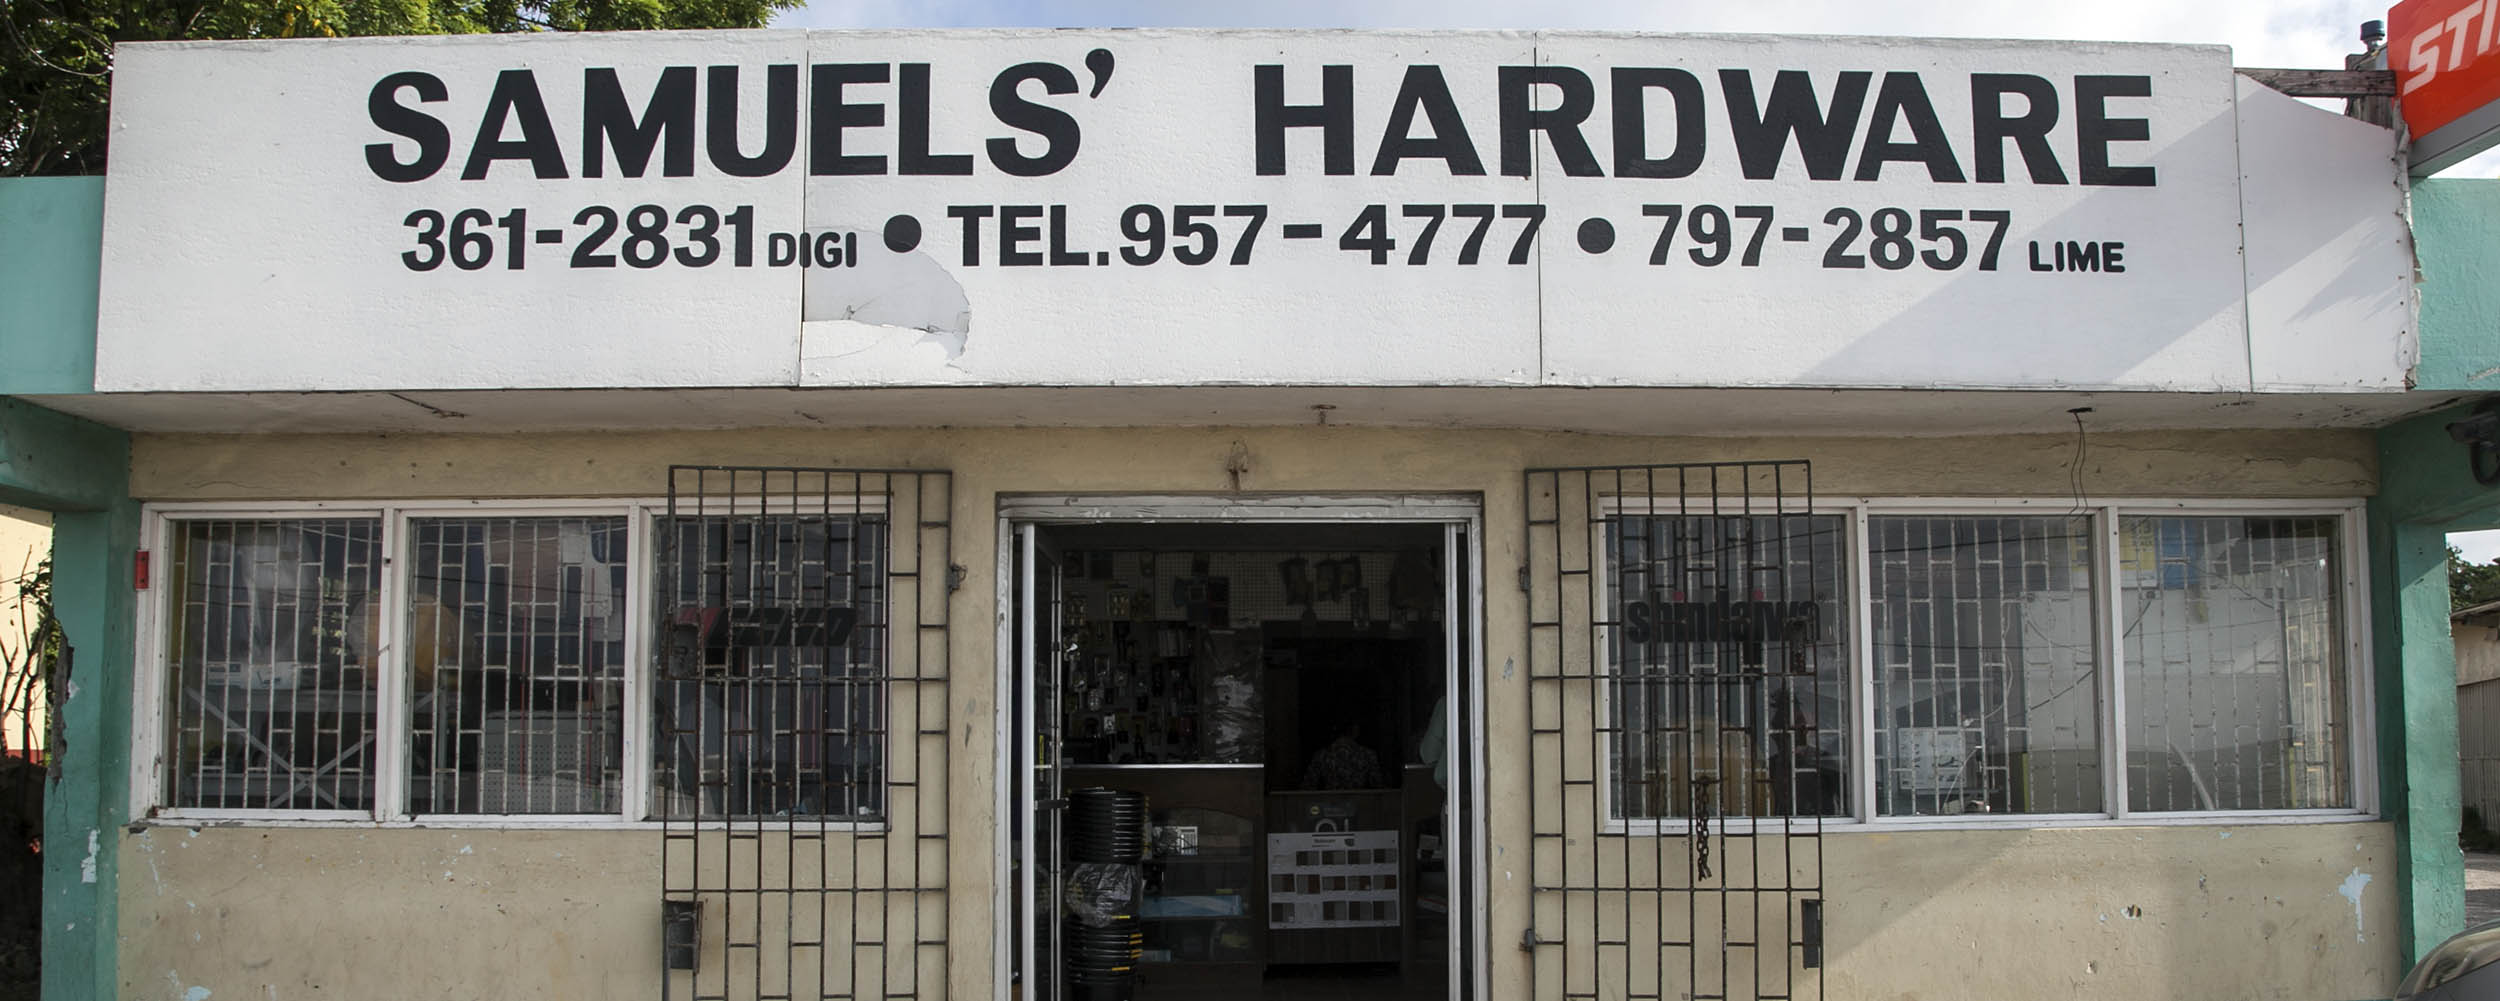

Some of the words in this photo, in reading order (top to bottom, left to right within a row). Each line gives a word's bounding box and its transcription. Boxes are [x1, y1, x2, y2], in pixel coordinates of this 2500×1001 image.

[2403, 0, 2500, 95] STI
[365, 48, 1114, 183] SAMUELS’
[1254, 64, 2157, 187] HARDWARE
[401, 205, 754, 272] 361-2831
[768, 231, 857, 269] DIGI
[1642, 204, 2011, 272] 797-2857
[2029, 241, 2126, 273] LIME
